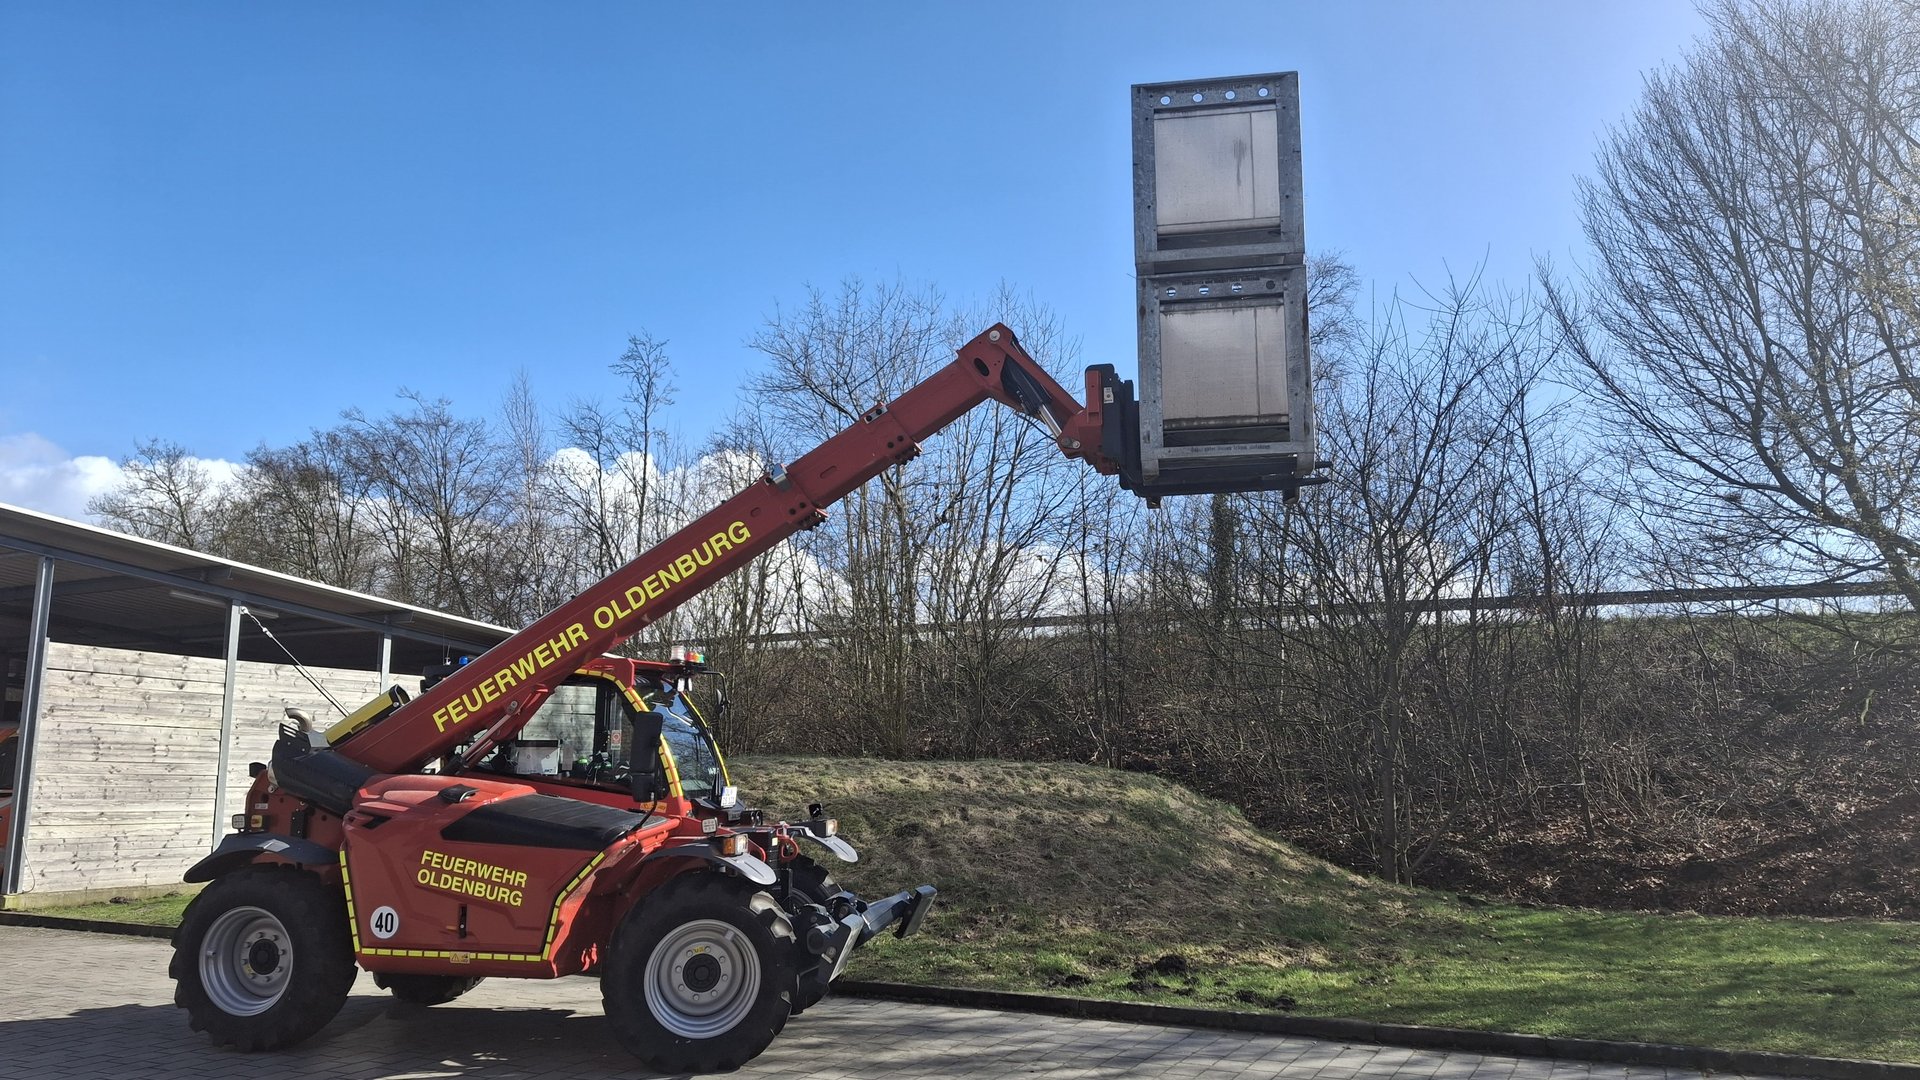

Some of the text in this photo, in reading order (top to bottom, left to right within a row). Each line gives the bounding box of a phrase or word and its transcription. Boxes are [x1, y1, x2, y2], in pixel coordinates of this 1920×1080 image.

[431, 520, 752, 734] FEUERWEHR OLDENBURG
[417, 868, 523, 907] OLDENBURG
[420, 850, 528, 888] FEUERWEHR
[374, 911, 395, 934] 40
